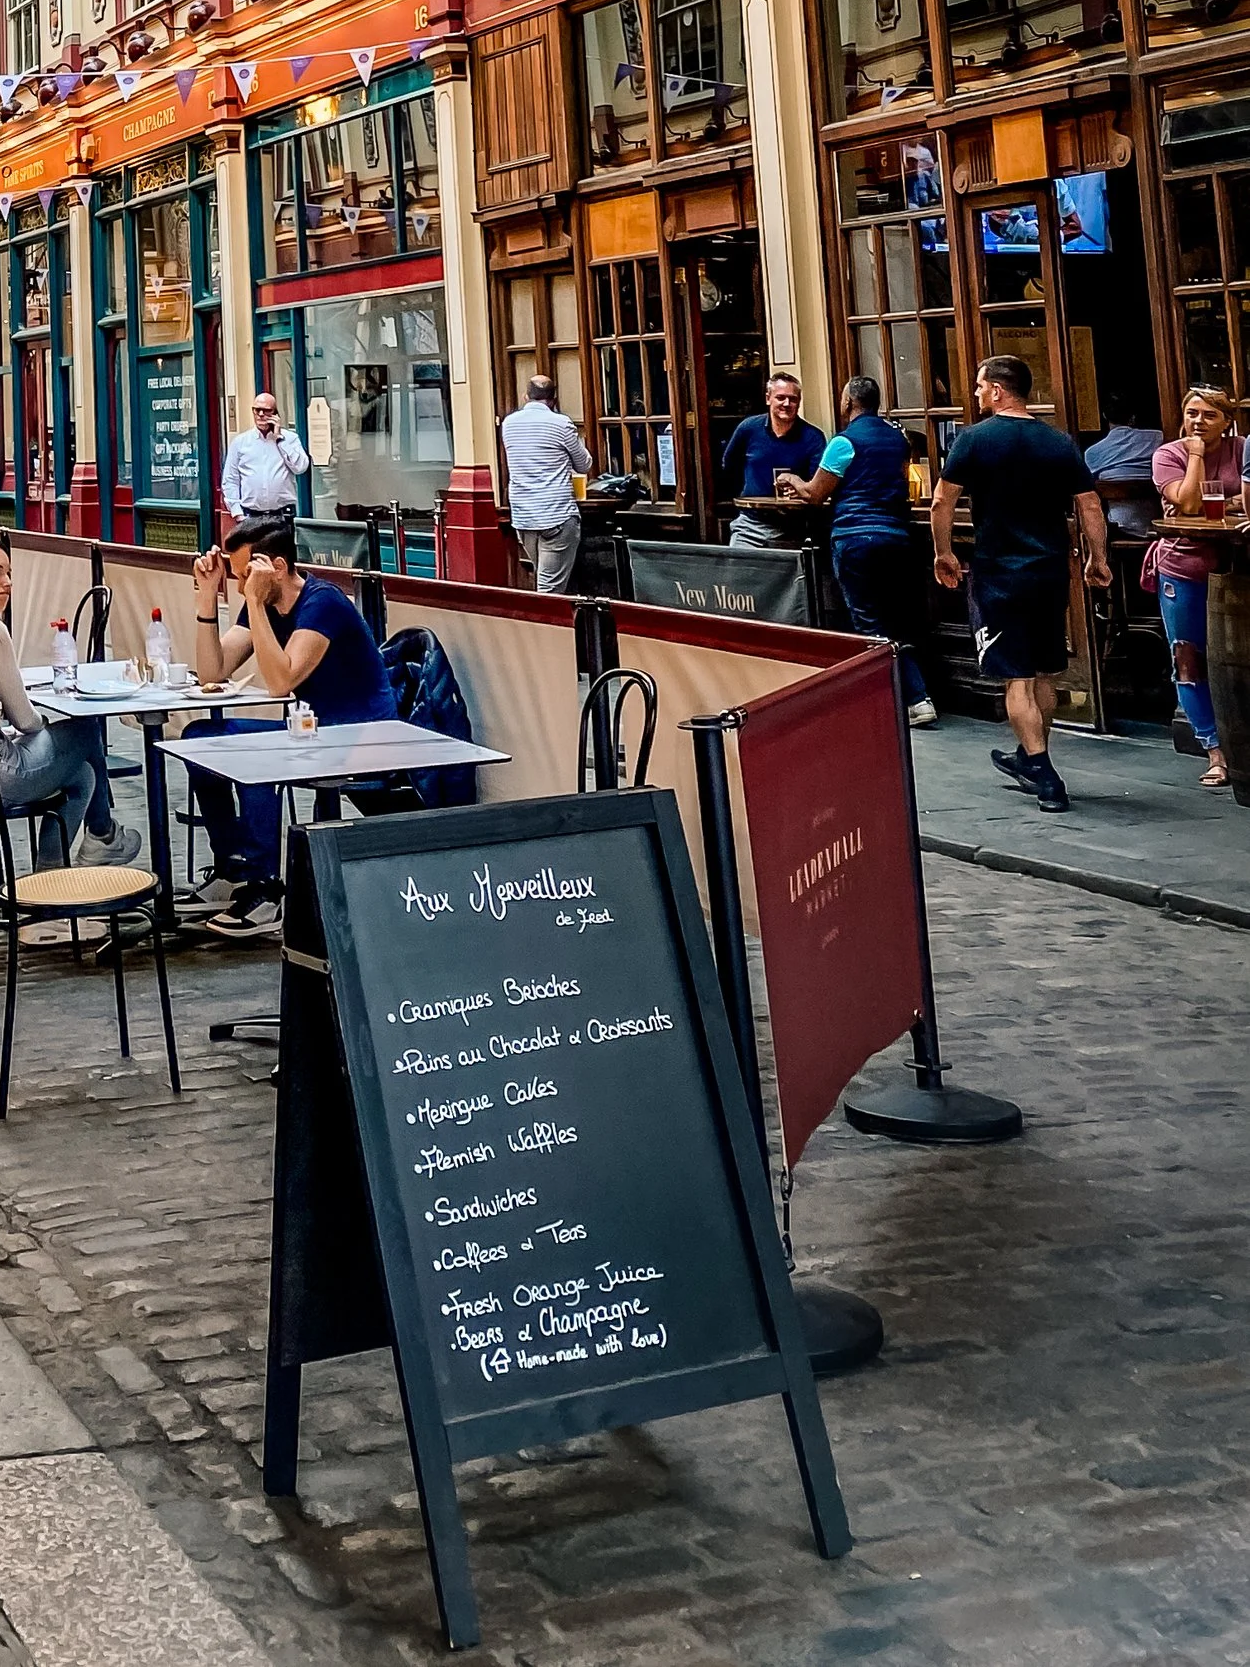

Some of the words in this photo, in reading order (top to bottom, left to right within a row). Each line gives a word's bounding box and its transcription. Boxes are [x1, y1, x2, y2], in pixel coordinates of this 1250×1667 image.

[414, 5, 428, 30] 16
[123, 106, 176, 142] CHAMPAGNE
[20, 160, 44, 183] SPIRITS
[147, 378, 159, 389] FREE
[159, 377, 173, 388] LOCAL
[674, 581, 706, 607] New
[713, 584, 756, 613] Moon
[399, 876, 455, 921] Aux
[469, 862, 597, 921] Merveilleux
[555, 911, 576, 926] de
[576, 908, 615, 934] Fred
[399, 992, 494, 1026] Cramiques
[503, 973, 581, 1005] Brioches
[401, 1048, 453, 1075] Pains
[458, 1048, 487, 1066] au
[489, 1026, 562, 1059] Chocolat
[587, 1006, 674, 1043] Croissants
[417, 1097, 494, 1130] Meringue
[503, 1076, 558, 1106] Cakes
[419, 1143, 496, 1179] Flemish
[507, 1122, 578, 1154] Waffles
[434, 1187, 538, 1226] Sandwiches
[441, 1242, 508, 1273] Coffees
[535, 1219, 588, 1244] Teas
[447, 1288, 504, 1321] Fresh
[513, 1278, 590, 1307] Orange
[594, 1261, 664, 1292] Juice
[456, 1325, 504, 1352] Beers
[539, 1297, 650, 1338] Champagne
[515, 1344, 589, 1370] Home-made
[595, 1333, 623, 1356] with
